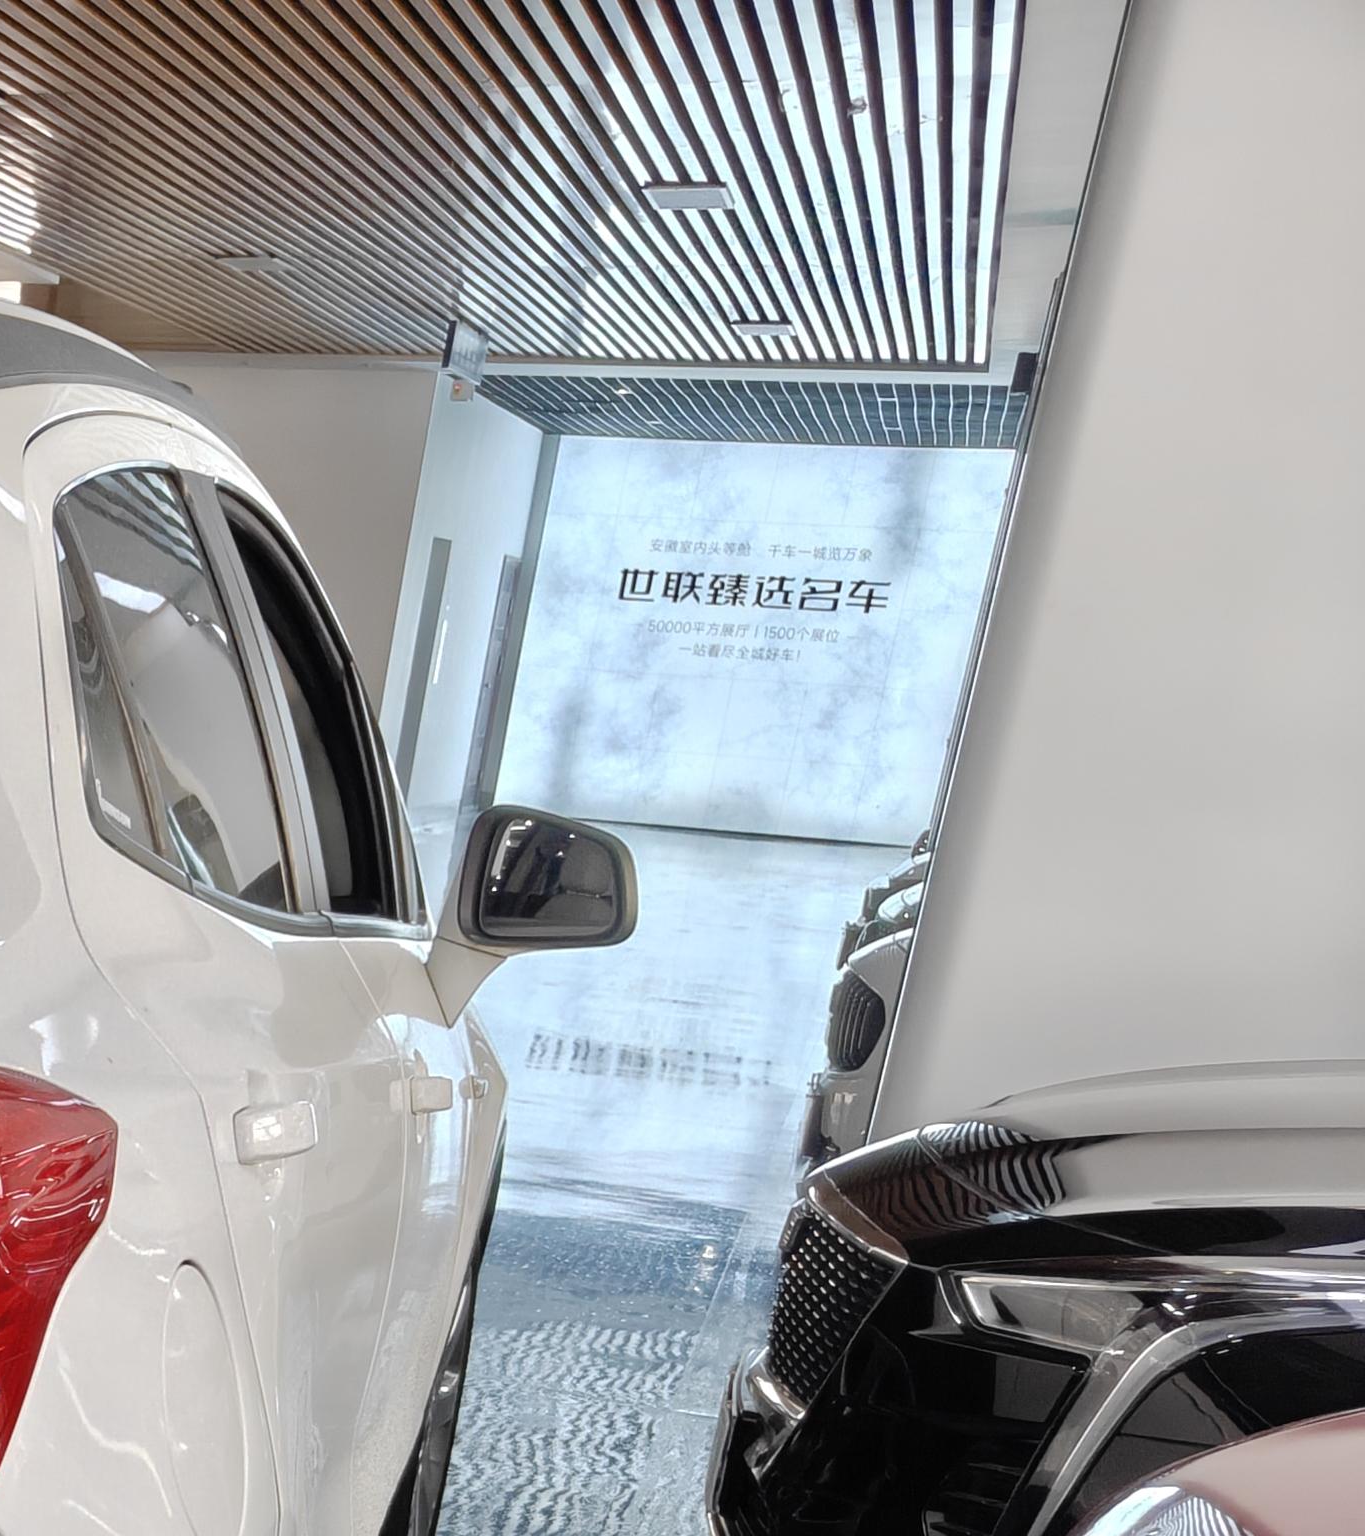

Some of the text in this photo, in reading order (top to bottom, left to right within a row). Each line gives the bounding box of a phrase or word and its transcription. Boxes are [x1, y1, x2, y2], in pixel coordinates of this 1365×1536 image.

[618, 568, 891, 614] 世联臻选名车
